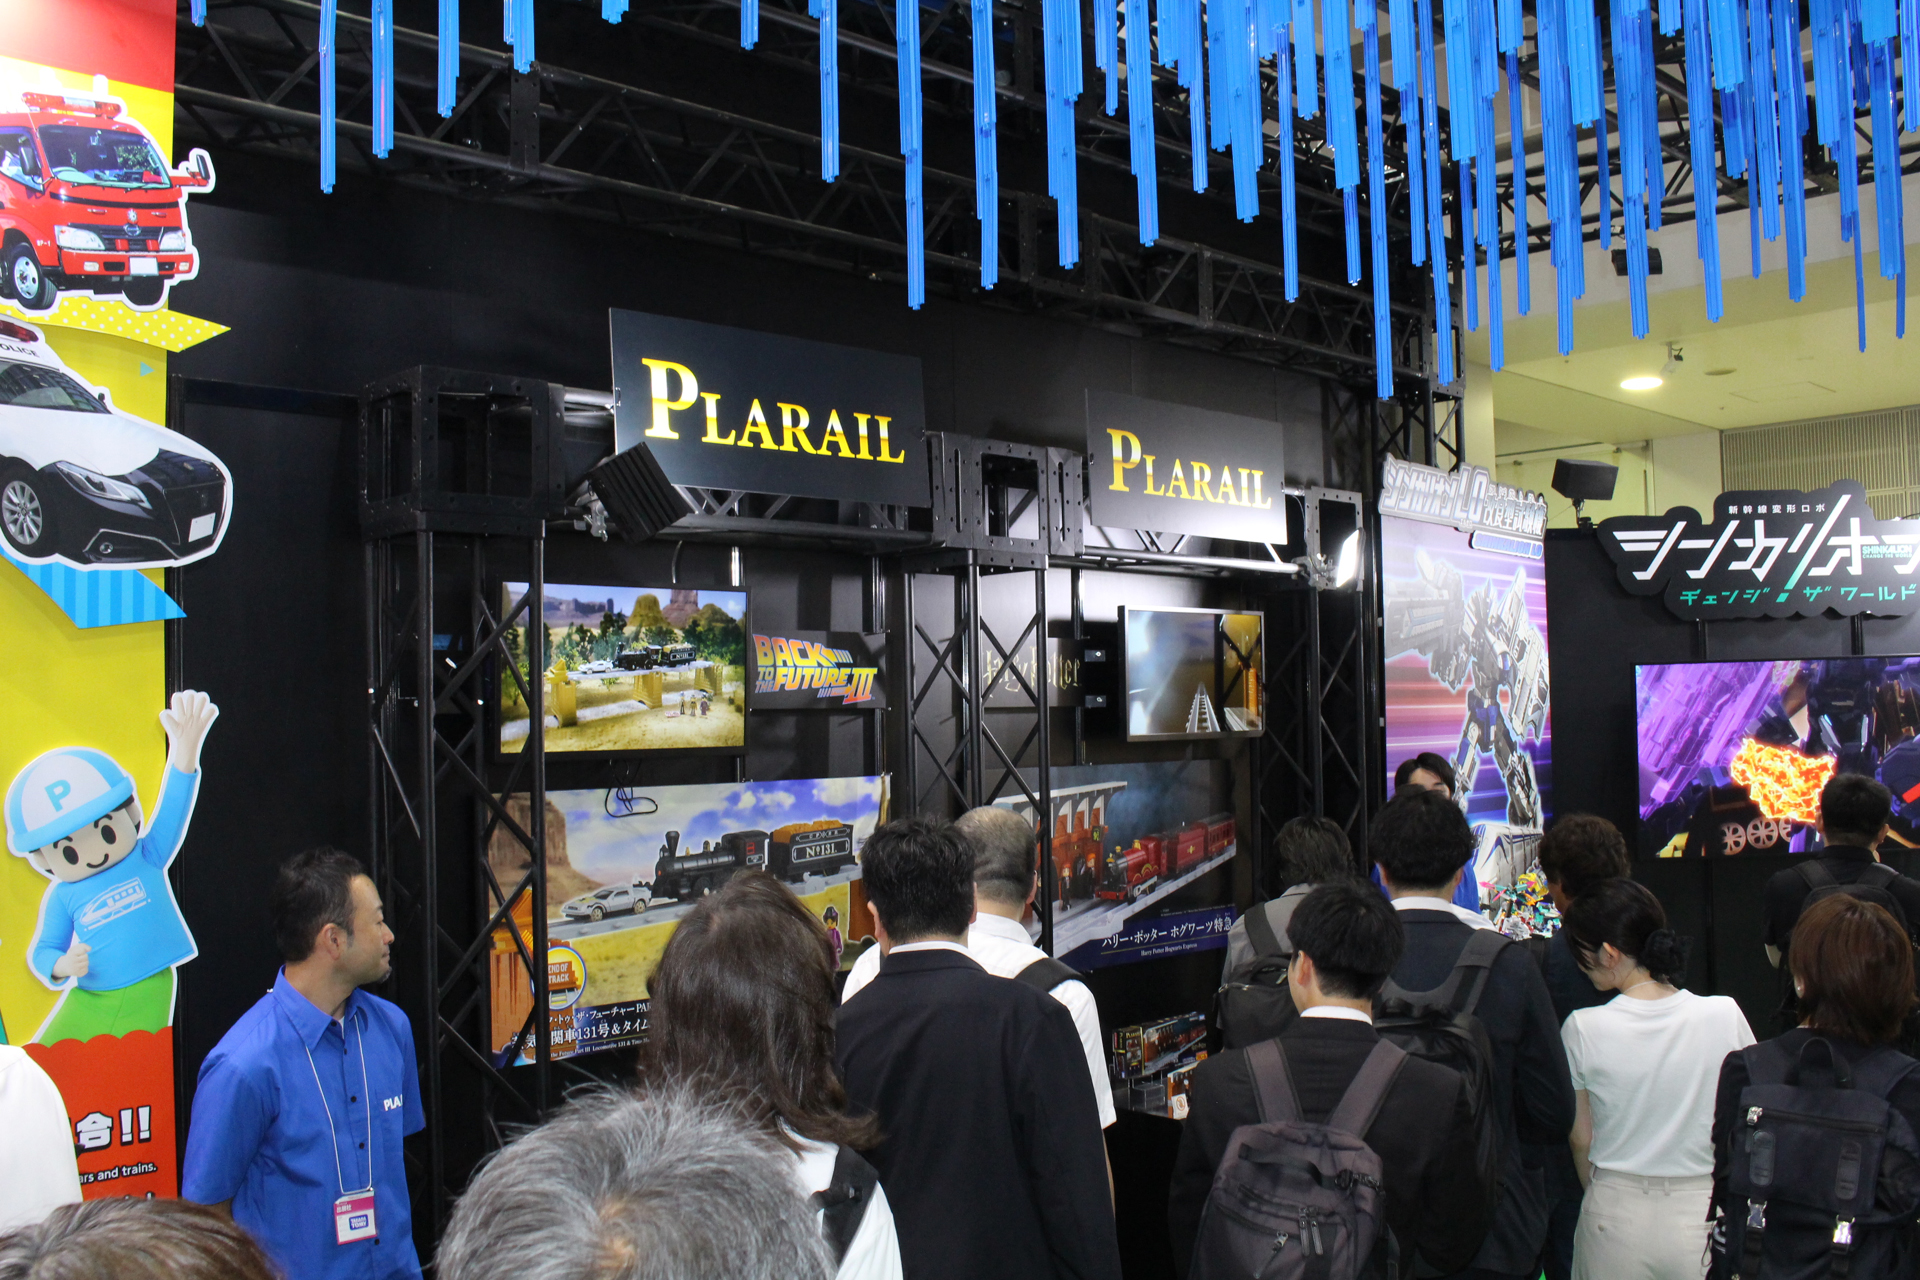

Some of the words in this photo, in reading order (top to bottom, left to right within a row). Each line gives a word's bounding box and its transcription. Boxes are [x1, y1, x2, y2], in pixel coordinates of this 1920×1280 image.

[0, 343, 40, 358] OLICE
[642, 358, 905, 463] PLARAIL
[1107, 428, 1272, 510] PLARAIL
[1728, 503, 1826, 515] 新幹線変形ロボ
[1862, 545, 1912, 554] SHINKALION
[753, 634, 838, 667] BACK
[758, 667, 774, 681] TO
[773, 667, 851, 691] FUTURE
[755, 680, 775, 693] THE
[842, 667, 878, 705] III
[44, 779, 71, 812] P
[1170, 916, 1232, 938] ホグワーツ特急
[548, 964, 560, 974] END
[561, 963, 569, 972] OF
[75, 1105, 151, 1151] 合!!
[79, 1173, 95, 1184] ars
[97, 1167, 119, 1181] and
[122, 1162, 157, 1177] trains.
